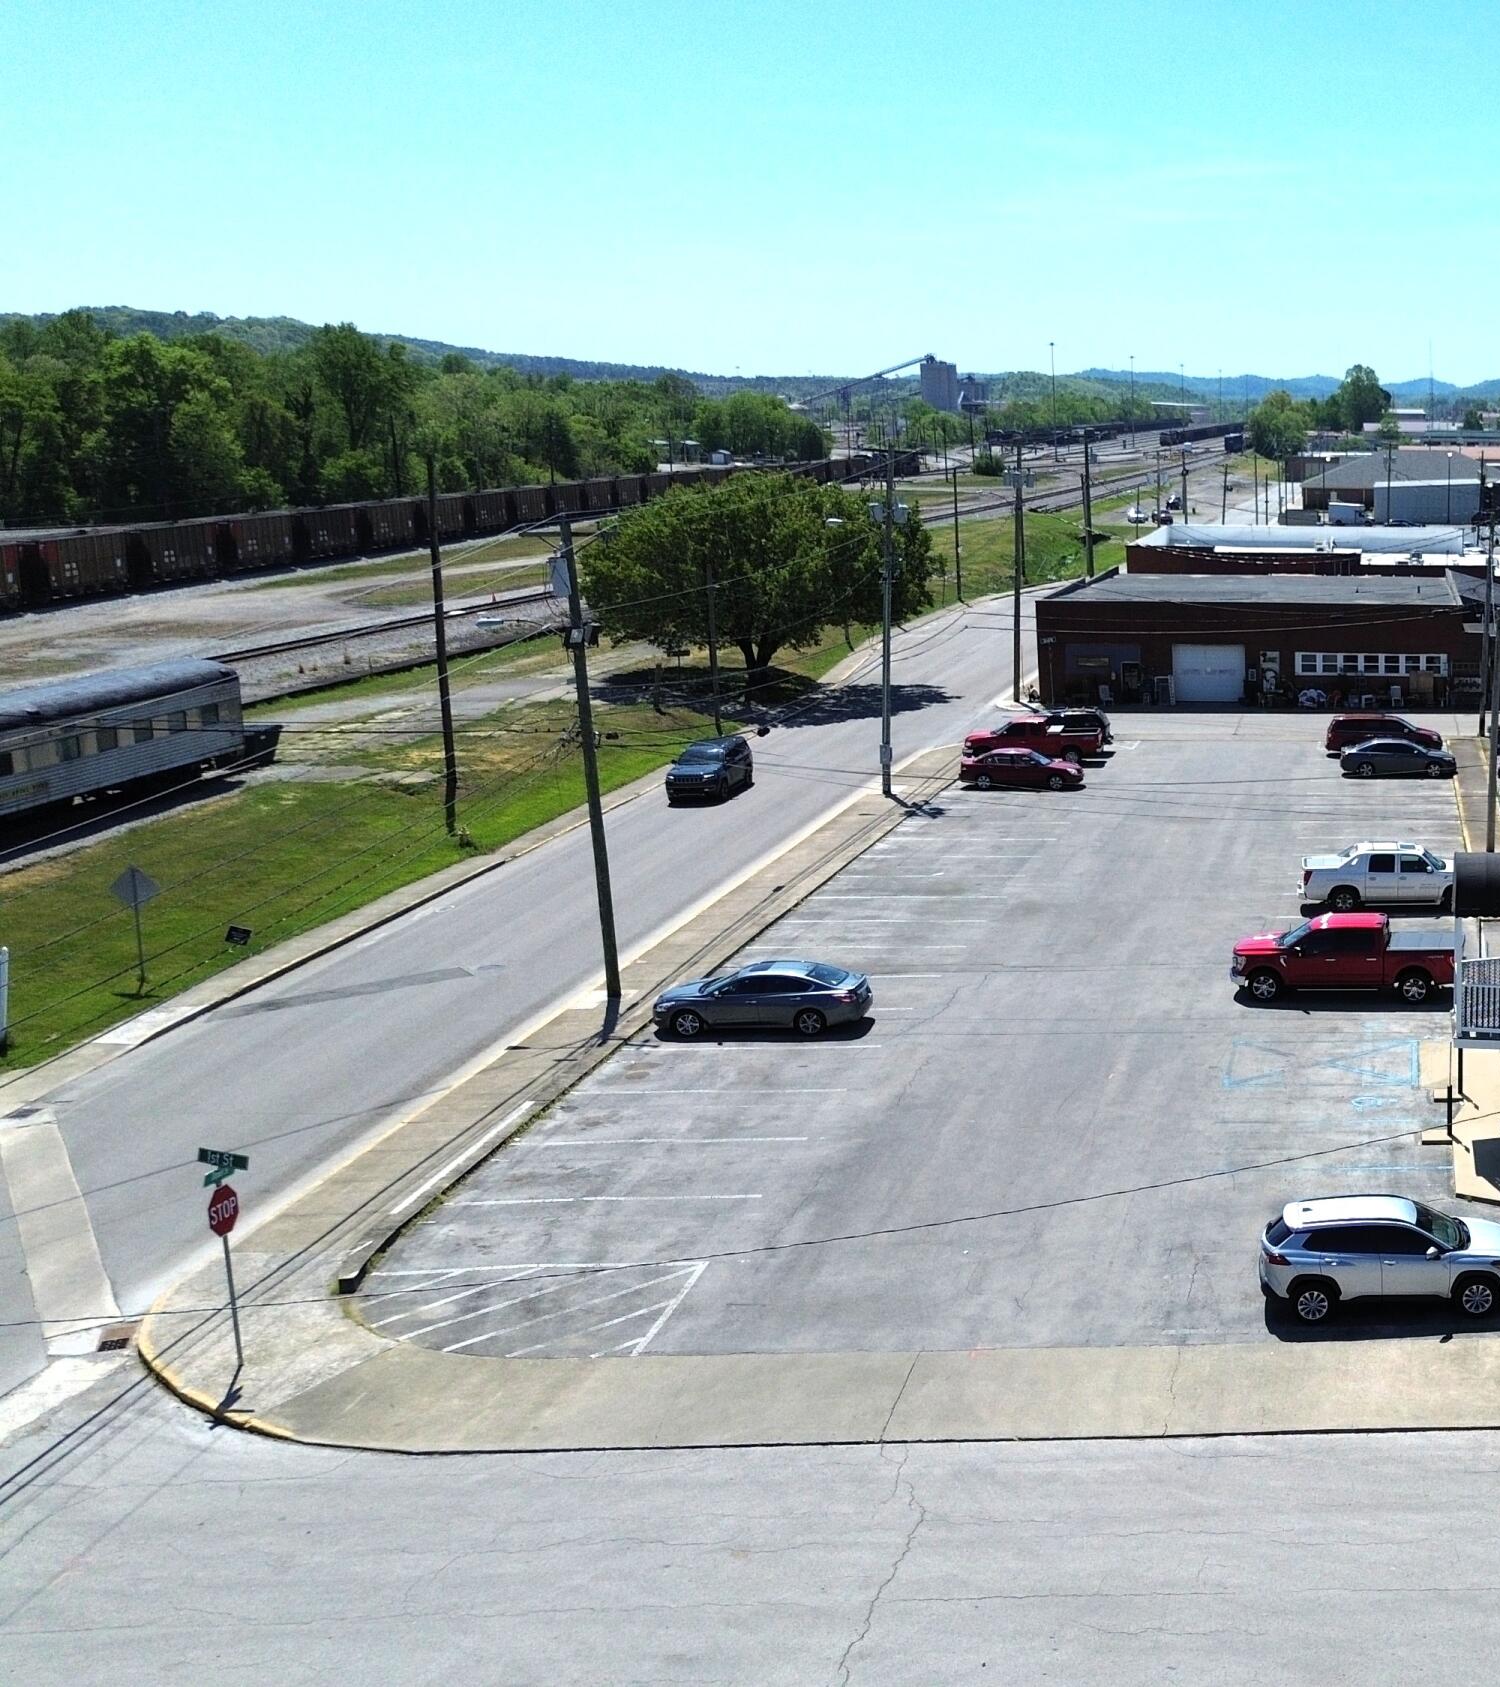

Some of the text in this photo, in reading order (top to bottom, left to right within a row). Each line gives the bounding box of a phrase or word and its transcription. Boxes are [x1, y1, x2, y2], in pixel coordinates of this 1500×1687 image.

[207, 1151, 234, 1167] 1st St
[210, 1197, 237, 1225] STOP
